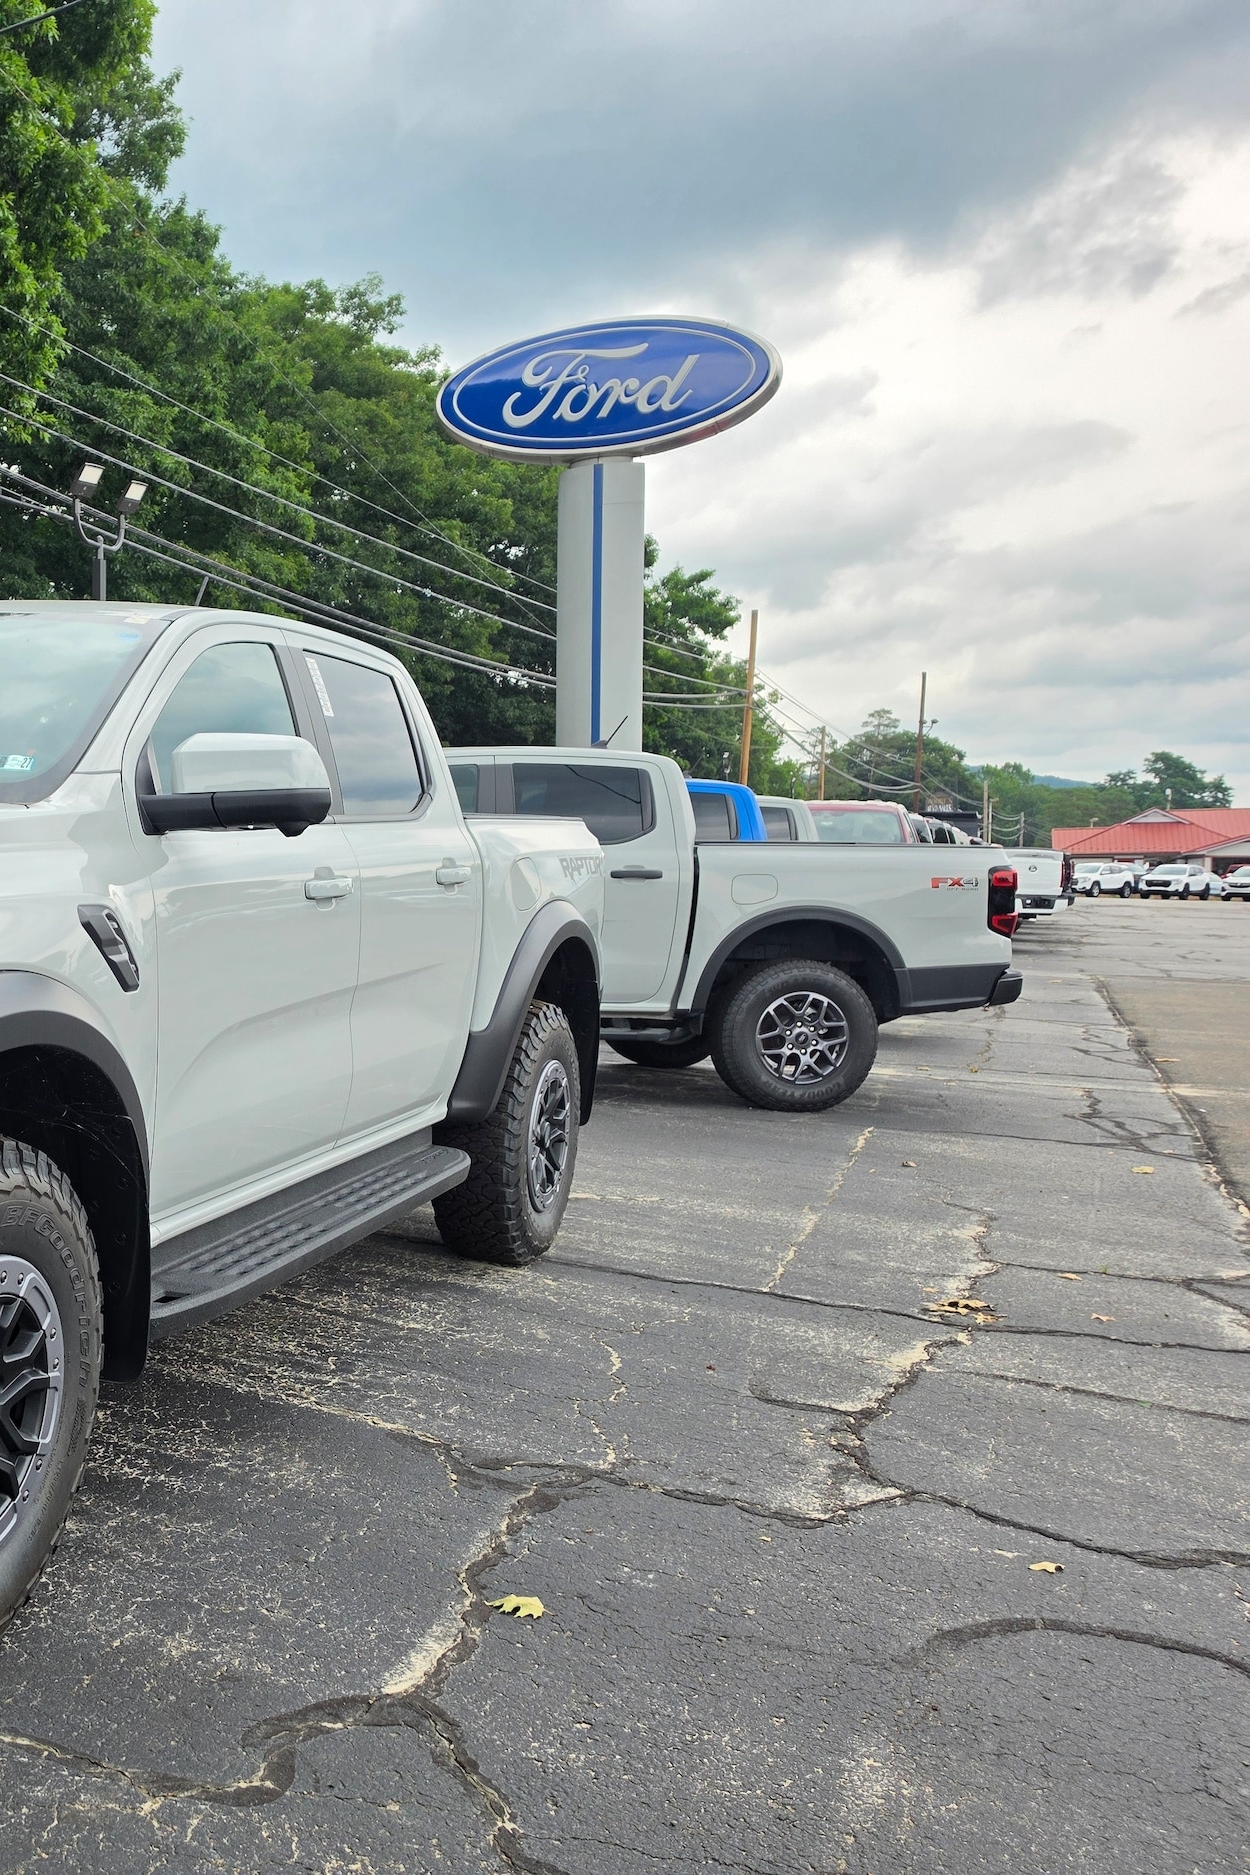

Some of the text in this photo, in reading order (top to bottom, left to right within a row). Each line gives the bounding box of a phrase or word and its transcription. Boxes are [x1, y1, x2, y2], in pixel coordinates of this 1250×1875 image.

[502, 342, 701, 428] Ford
[20, 757, 32, 768] 27
[558, 856, 602, 885] RAPTOR
[931, 877, 979, 889] FX4
[0, 1205, 92, 1389] BFGoodrich
